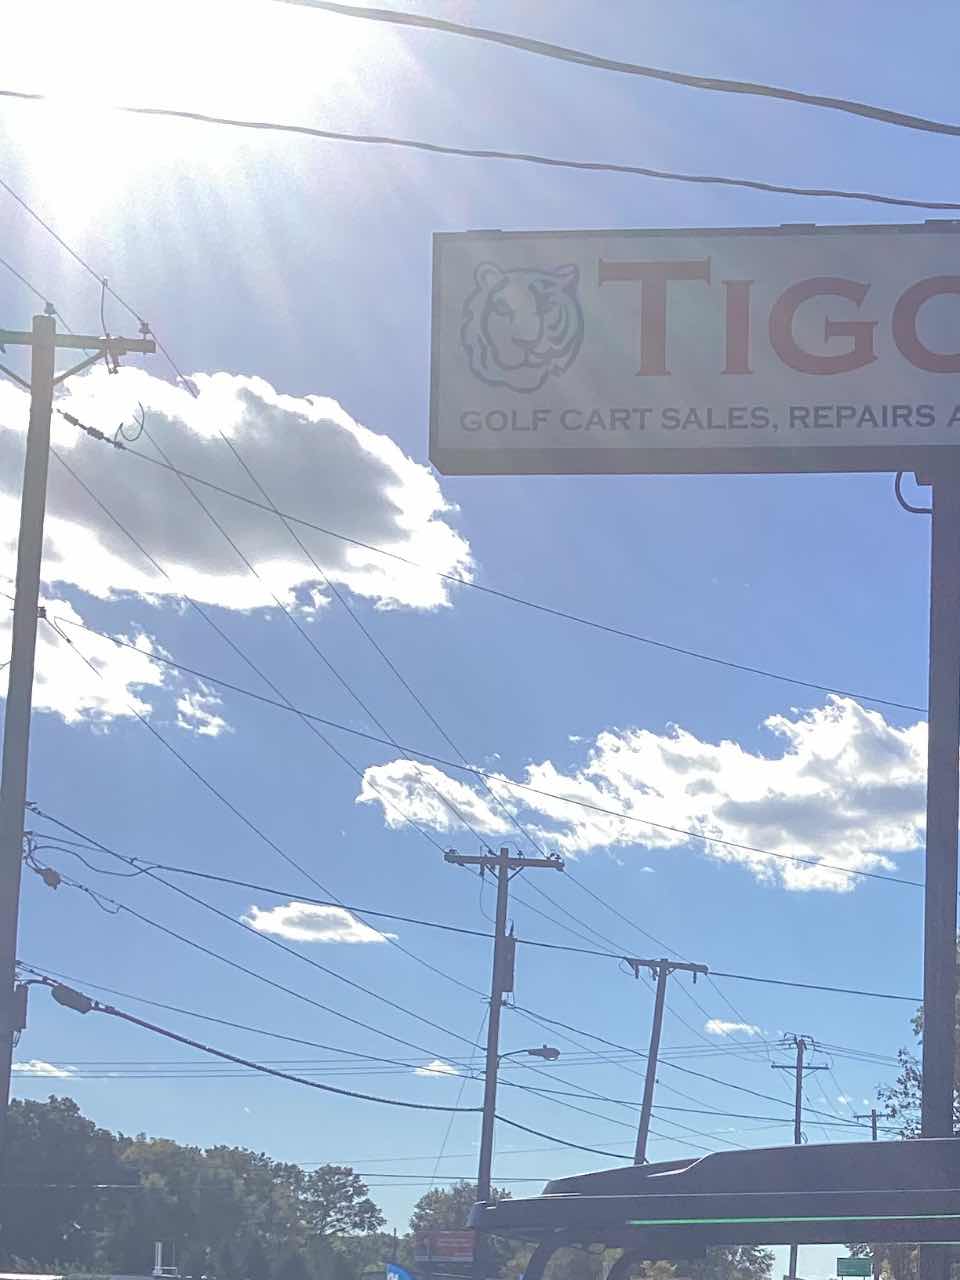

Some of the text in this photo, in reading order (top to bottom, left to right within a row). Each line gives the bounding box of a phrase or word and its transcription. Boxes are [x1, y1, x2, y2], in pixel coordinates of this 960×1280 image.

[460, 408, 549, 432] GOLF
[559, 407, 653, 431] CART
[661, 406, 779, 432] SALES,
[789, 405, 936, 430] REPAIRS
